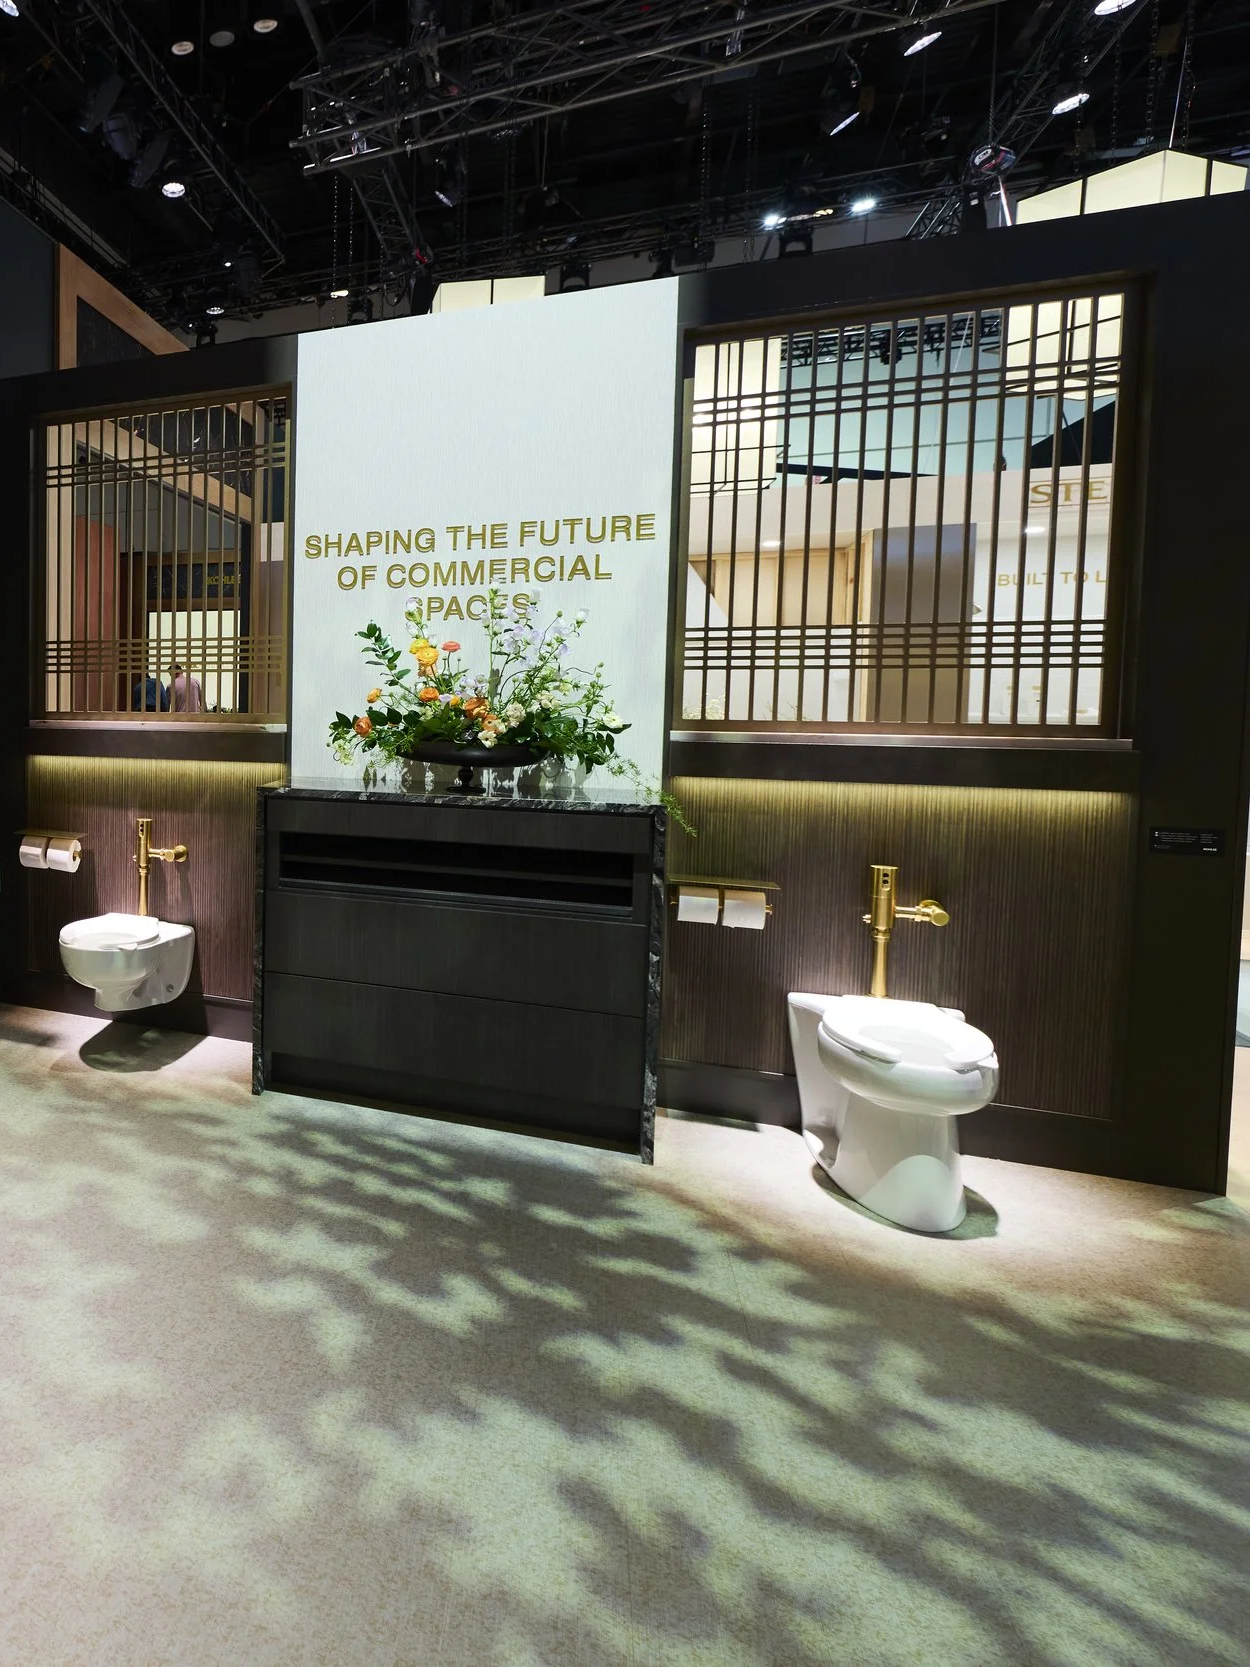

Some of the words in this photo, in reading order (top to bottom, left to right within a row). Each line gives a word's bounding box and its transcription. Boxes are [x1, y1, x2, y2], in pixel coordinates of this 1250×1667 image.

[305, 528, 436, 559] SHAPING
[446, 523, 508, 551] THE
[519, 513, 656, 547] FUTURE
[206, 575, 241, 585] KOHLE
[337, 566, 377, 591] OF
[386, 554, 613, 589] COMMERCIAL
